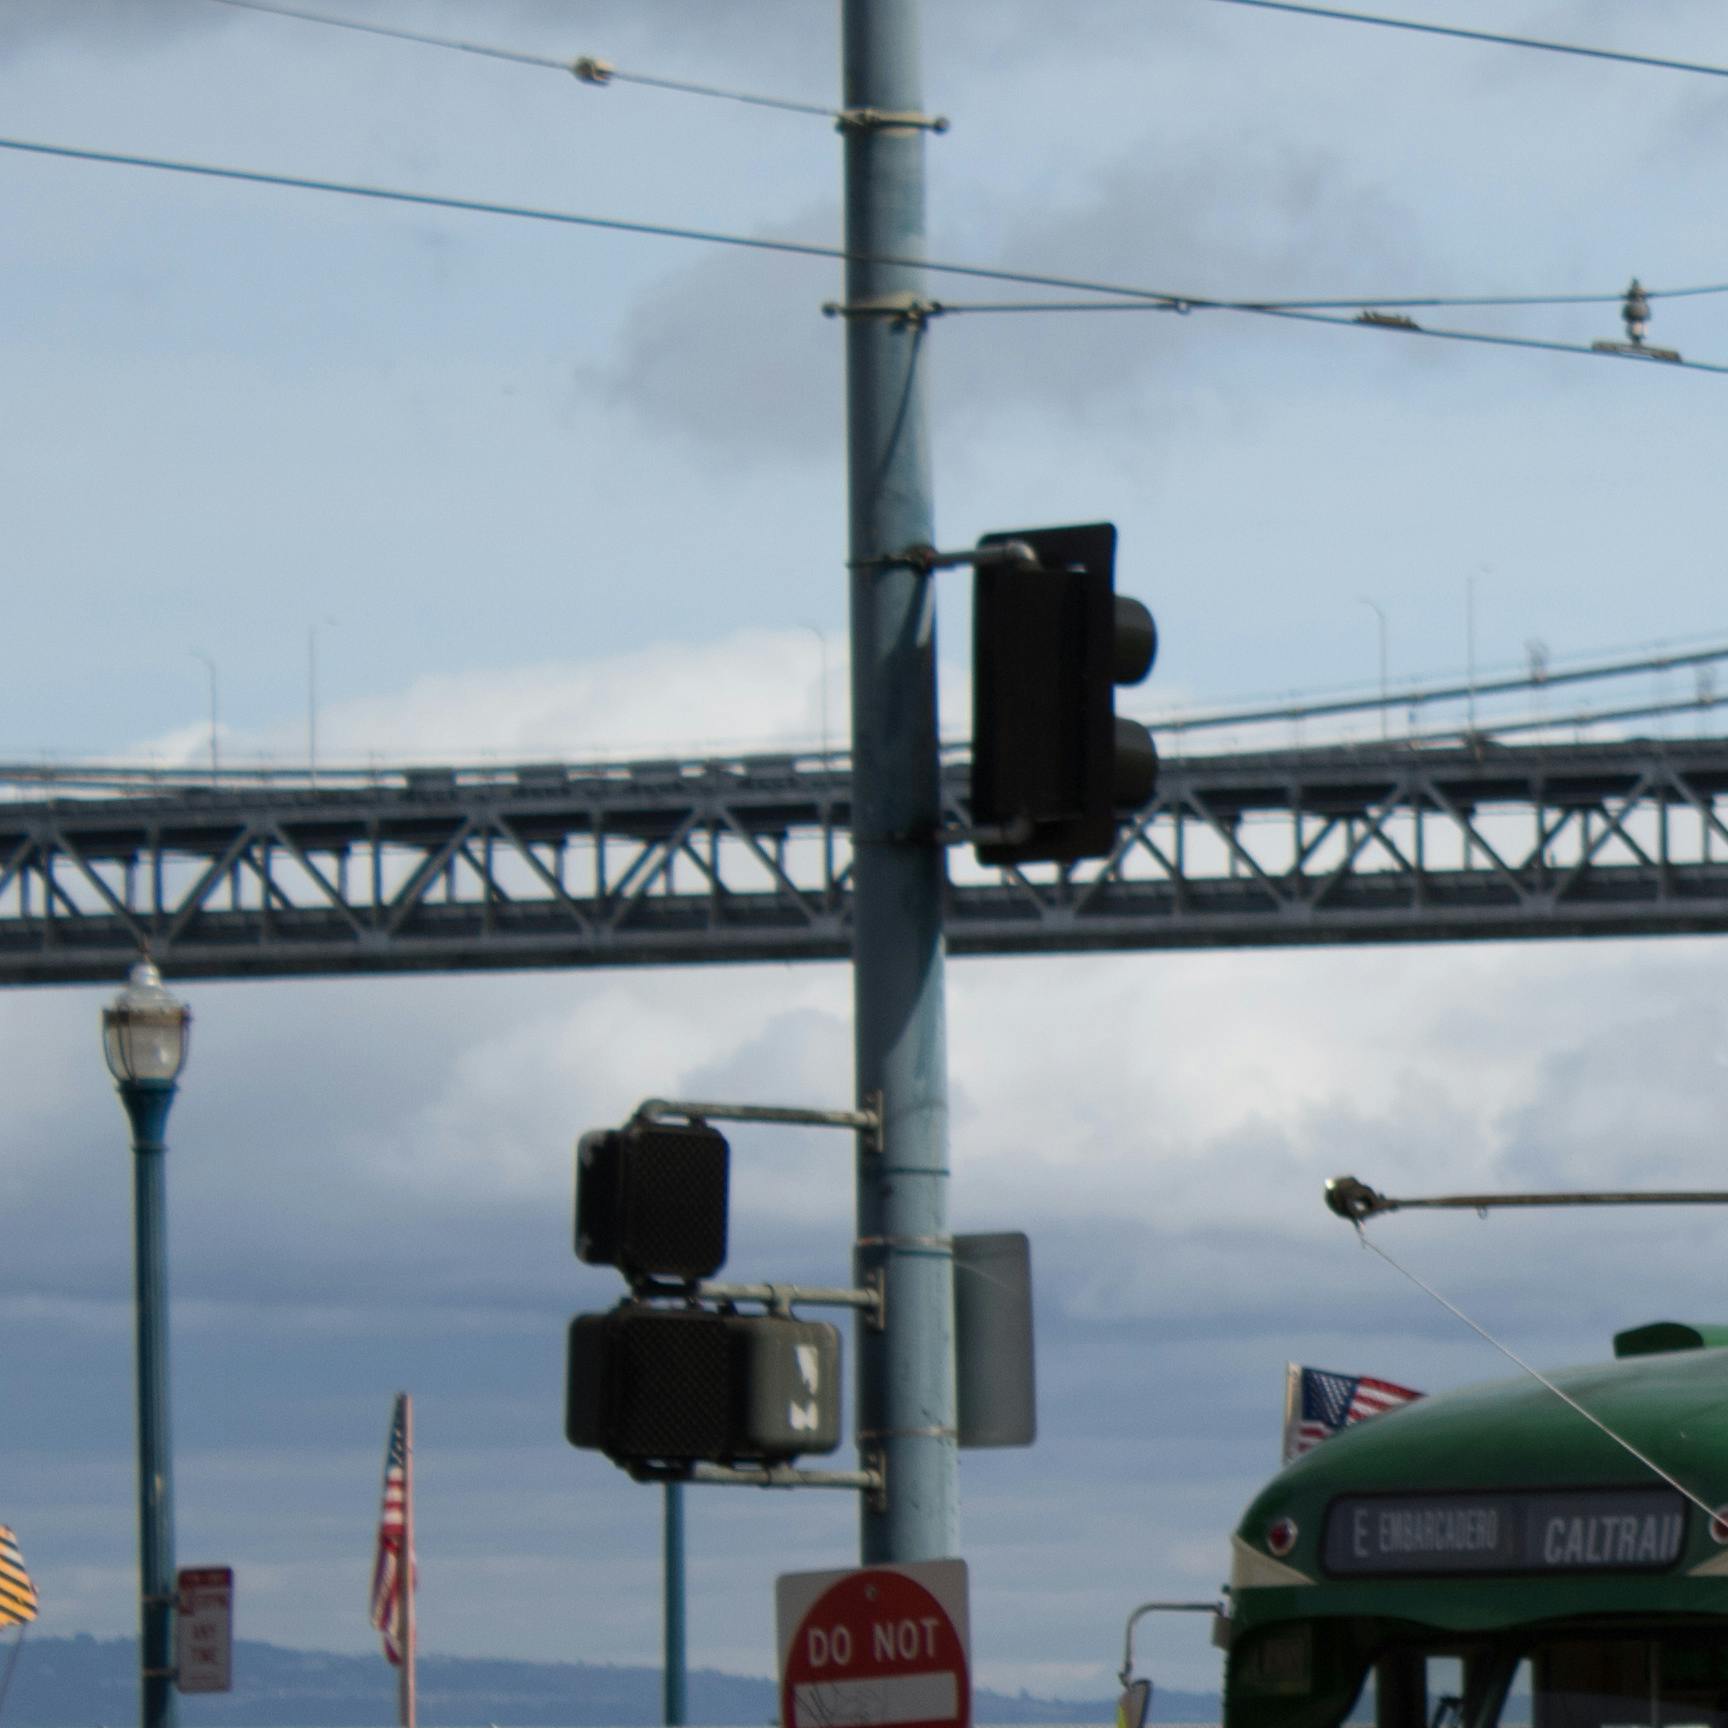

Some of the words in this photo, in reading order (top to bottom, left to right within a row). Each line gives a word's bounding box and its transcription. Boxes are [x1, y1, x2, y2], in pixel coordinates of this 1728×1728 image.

[1353, 1508, 1370, 1557] E
[1379, 1508, 1498, 1552] EMBARCADERO
[807, 1626, 851, 1668] DO
[872, 1618, 939, 1664] NOT
